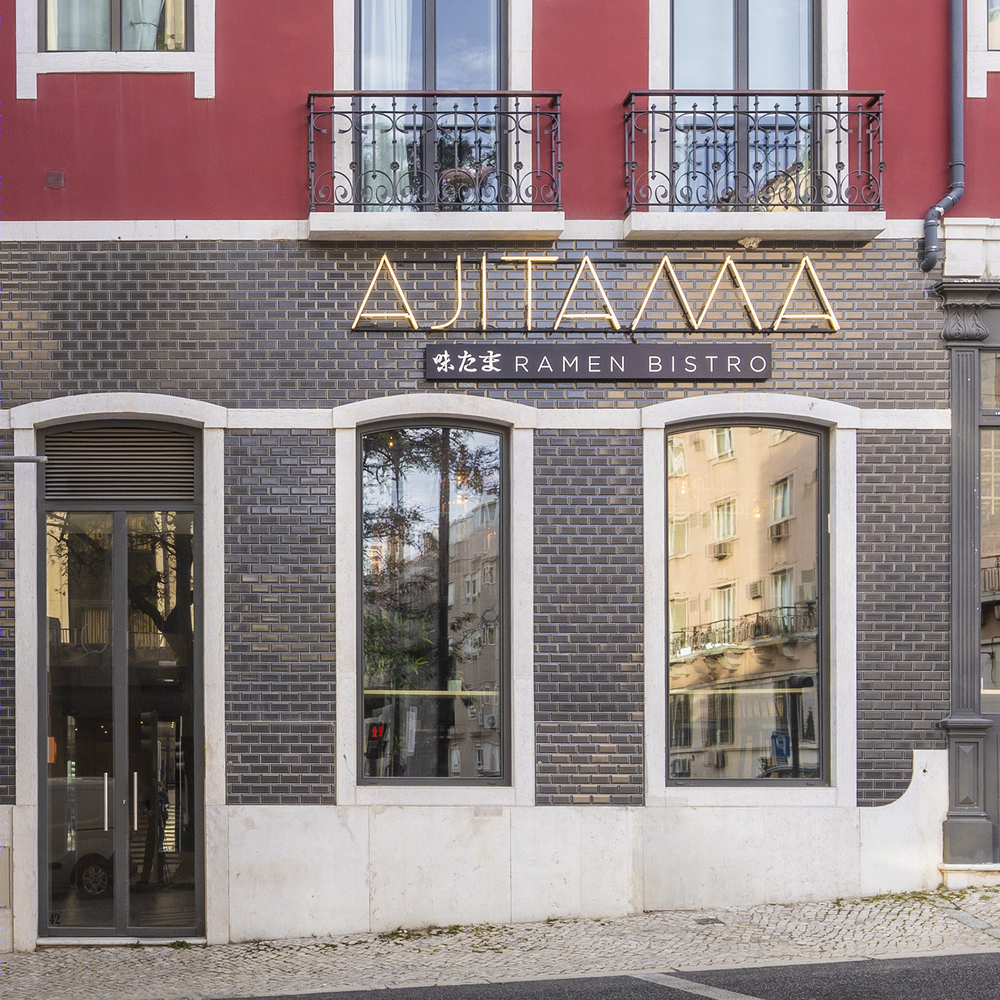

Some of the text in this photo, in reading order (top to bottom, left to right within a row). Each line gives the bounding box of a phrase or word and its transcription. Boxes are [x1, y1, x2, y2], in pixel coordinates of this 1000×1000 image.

[351, 254, 841, 331] AJITAMA
[432, 350, 502, 373] 味たま
[515, 355, 767, 373] RAMEN BISTRO
[49, 912, 61, 925] 42
